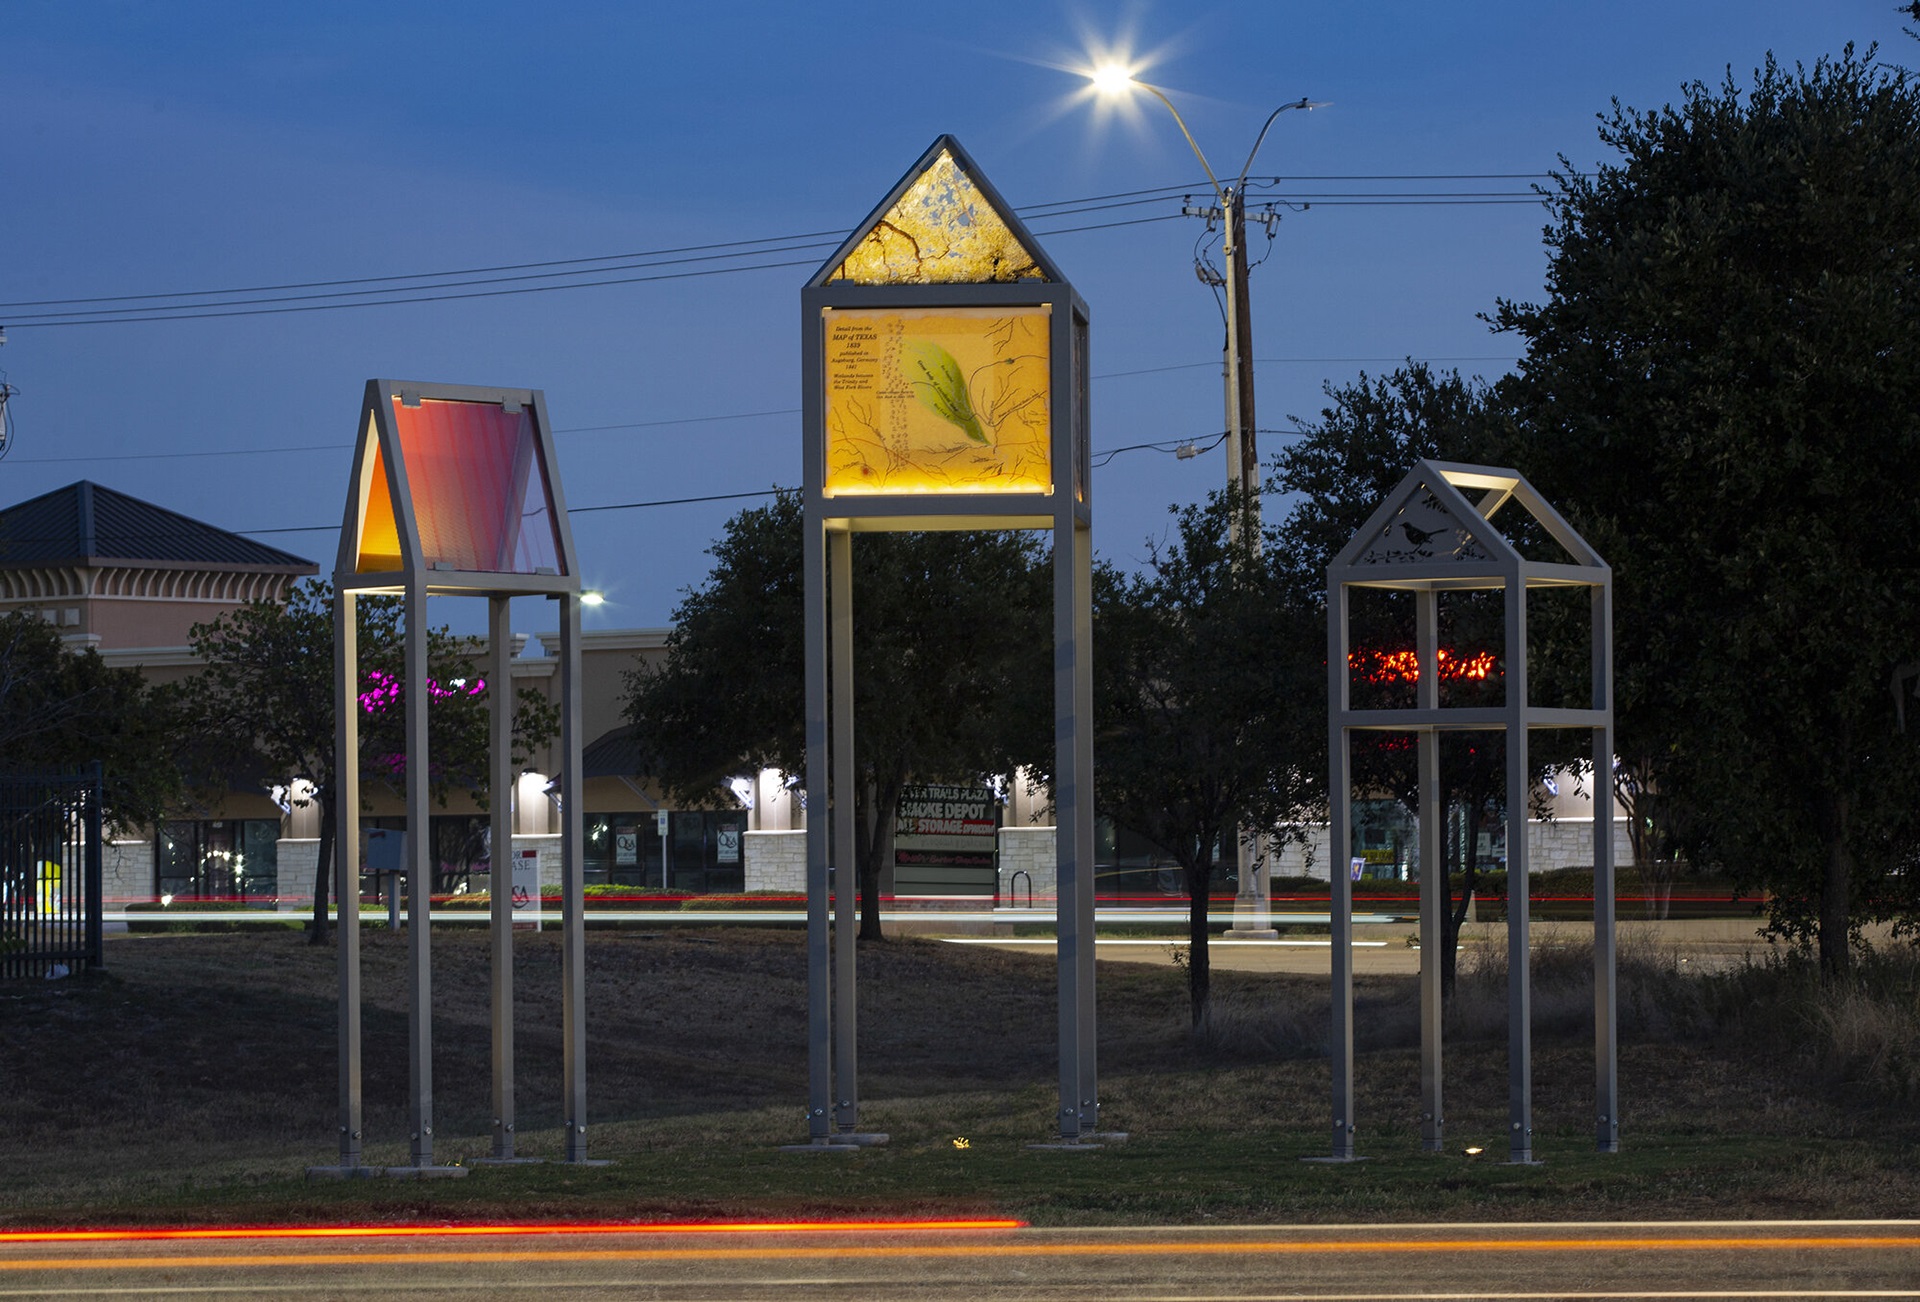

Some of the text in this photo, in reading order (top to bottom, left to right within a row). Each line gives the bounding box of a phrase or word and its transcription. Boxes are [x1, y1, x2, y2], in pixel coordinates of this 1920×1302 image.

[928, 787, 960, 800] TRAILS
[944, 802, 986, 819] DEPOT
[917, 819, 963, 833] STORAGE
